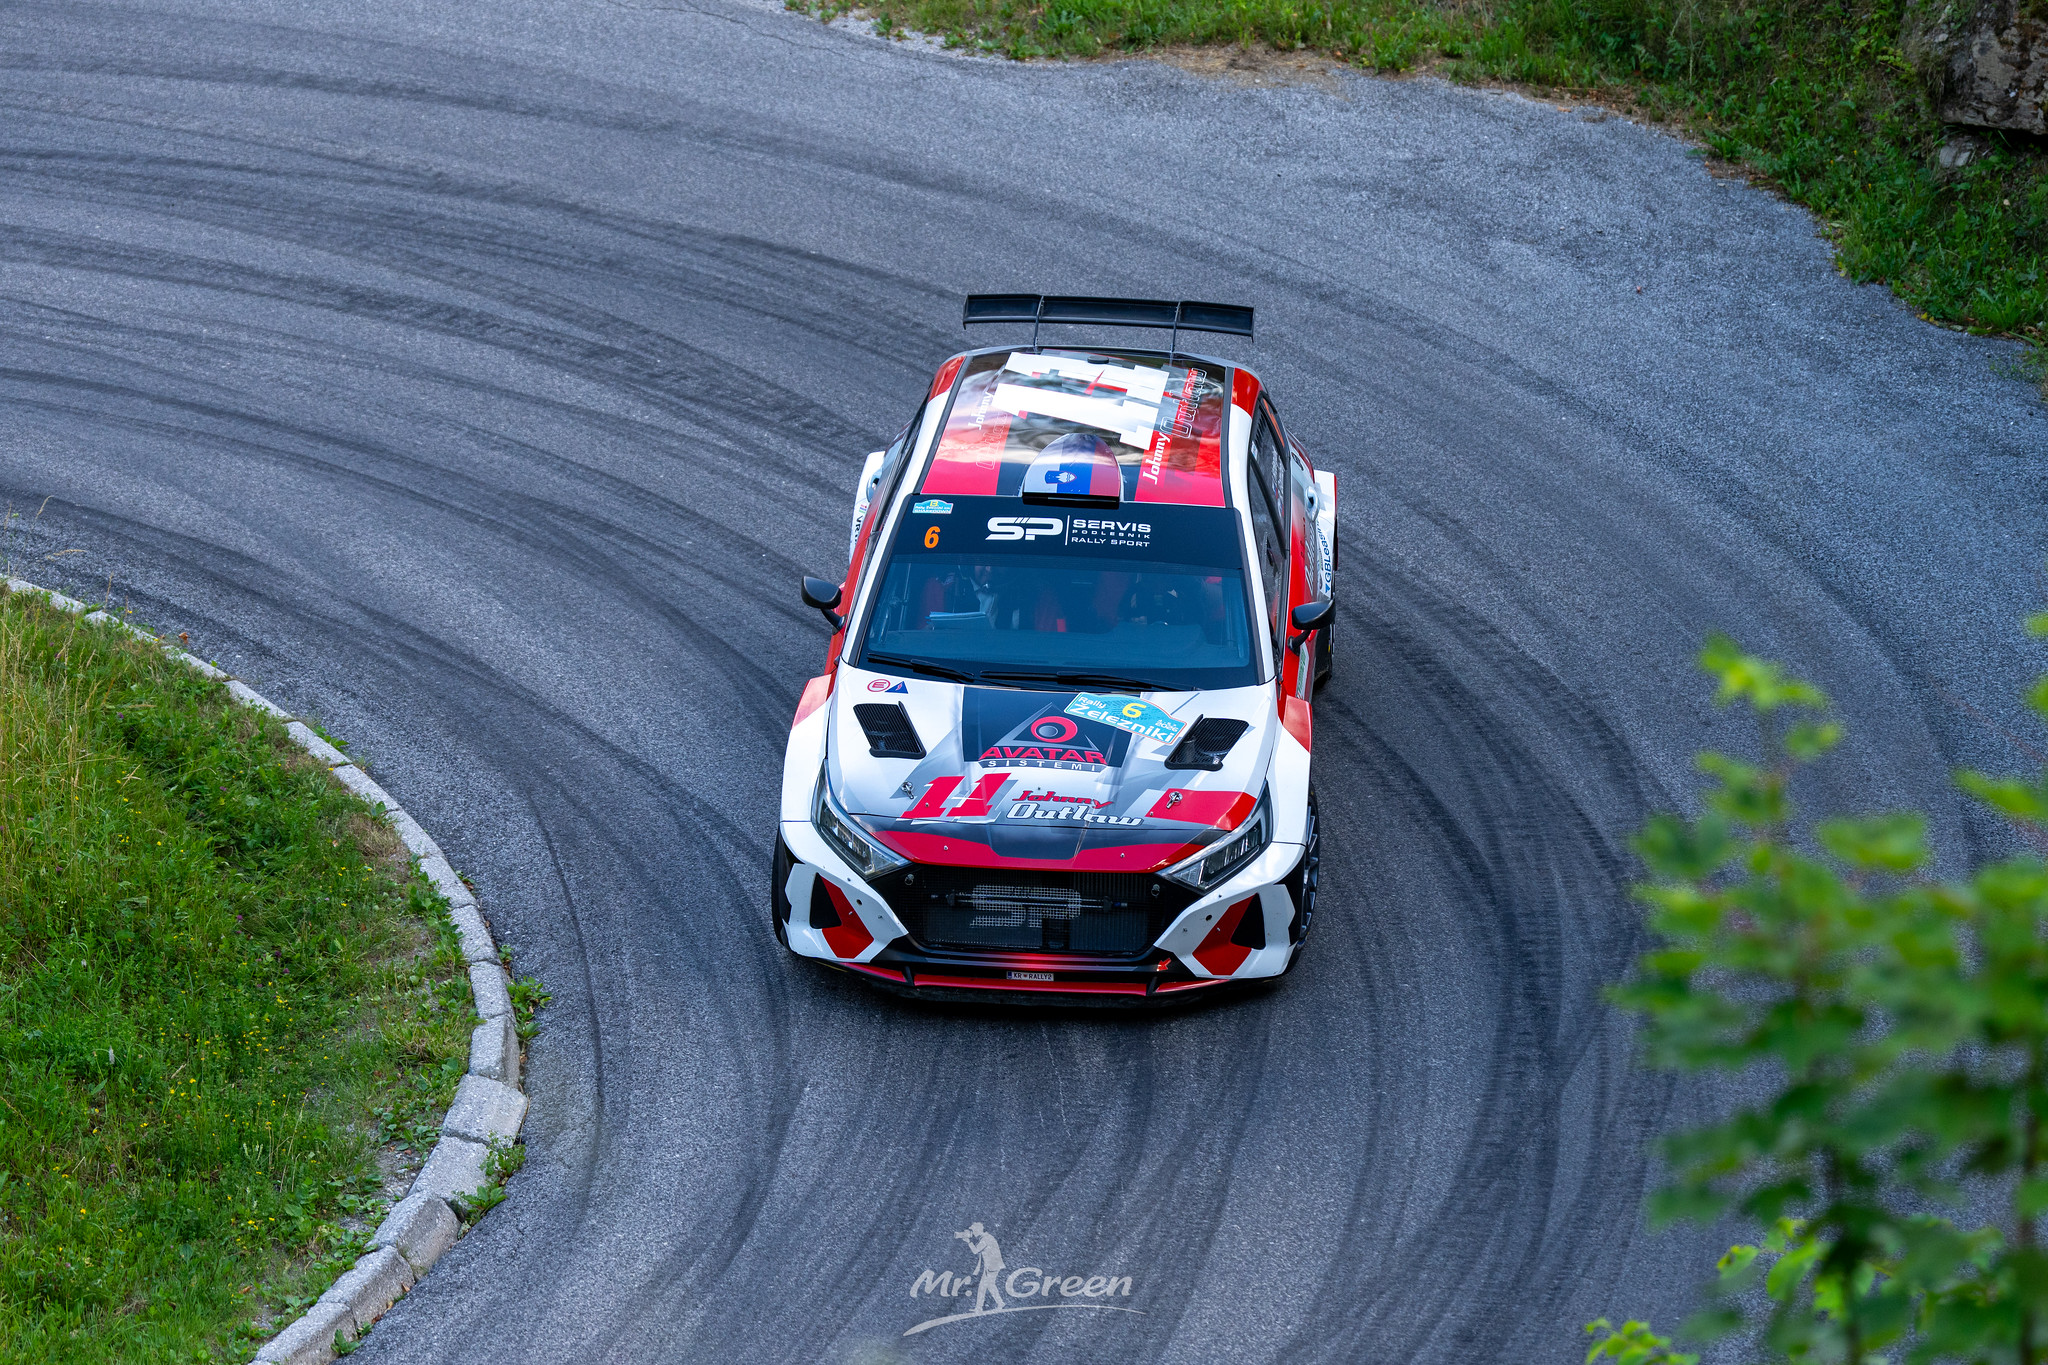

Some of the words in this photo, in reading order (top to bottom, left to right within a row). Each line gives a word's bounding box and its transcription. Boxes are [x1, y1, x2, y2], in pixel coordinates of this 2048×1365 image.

[1143, 432, 1170, 485] Johnny
[985, 516, 1064, 541] SP
[1072, 518, 1152, 533] SERVIS
[924, 526, 941, 549] 6
[1071, 536, 1107, 545] RALLY
[1110, 538, 1151, 548] SPORT
[1080, 696, 1107, 709] Rally
[1122, 702, 1147, 718] 6
[1069, 702, 1175, 743] Železniki
[978, 746, 1108, 765] AVATAR
[987, 759, 1096, 772] SISTEMI
[899, 772, 1012, 820] 11
[1012, 790, 1115, 809] Johnny
[1006, 802, 1145, 827] Outlaw
